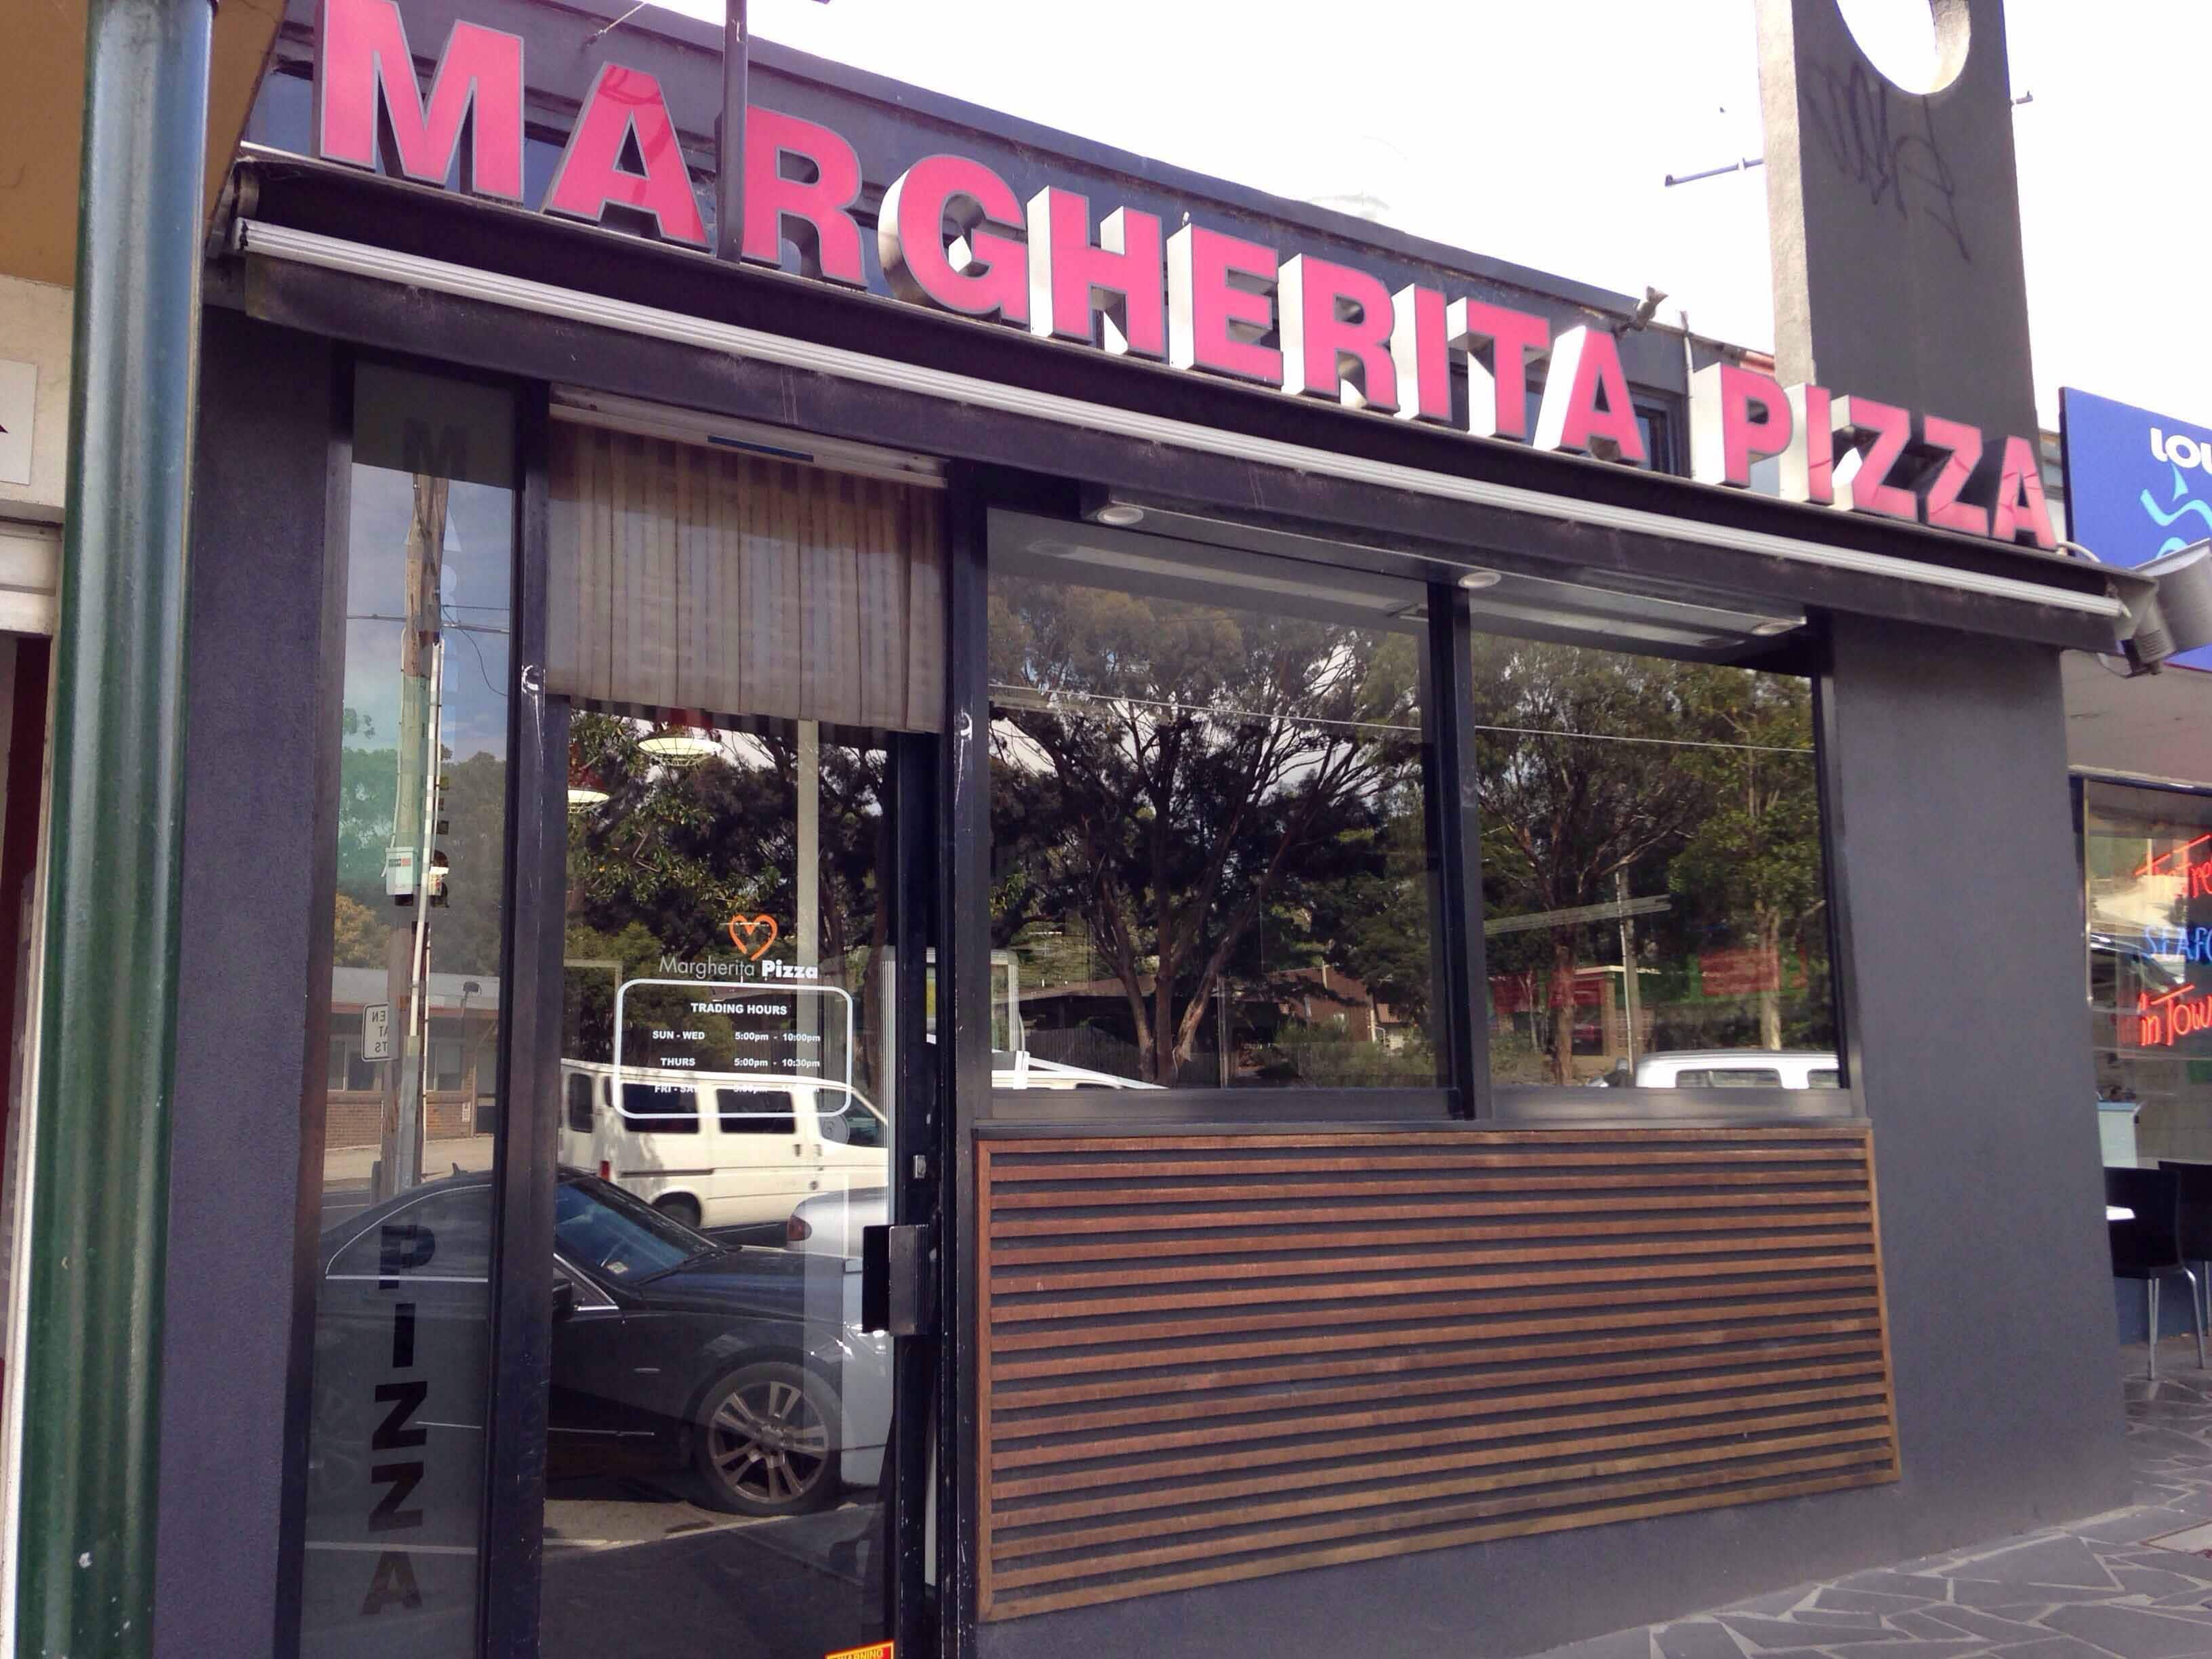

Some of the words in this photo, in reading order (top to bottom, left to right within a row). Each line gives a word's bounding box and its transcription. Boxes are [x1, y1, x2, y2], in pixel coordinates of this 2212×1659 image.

[319, 0, 1648, 464] MARGHERITA
[1691, 361, 2057, 549] PIZZA
[659, 955, 754, 979] Margherita
[762, 959, 819, 979] Pizza
[691, 1003, 744, 1015] TRADING
[747, 1005, 787, 1015] HOURS
[652, 1030, 674, 1040] SUN
[682, 1031, 705, 1040] WED
[735, 1031, 769, 1042] 5:00pm
[782, 1033, 821, 1042] 10:00pm
[660, 1057, 696, 1067] THURS
[734, 1058, 769, 1068] 5:00pm
[781, 1059, 821, 1068] 10:30pm
[654, 1084, 672, 1093] FRI
[361, 1224, 436, 1617] PIZZA
